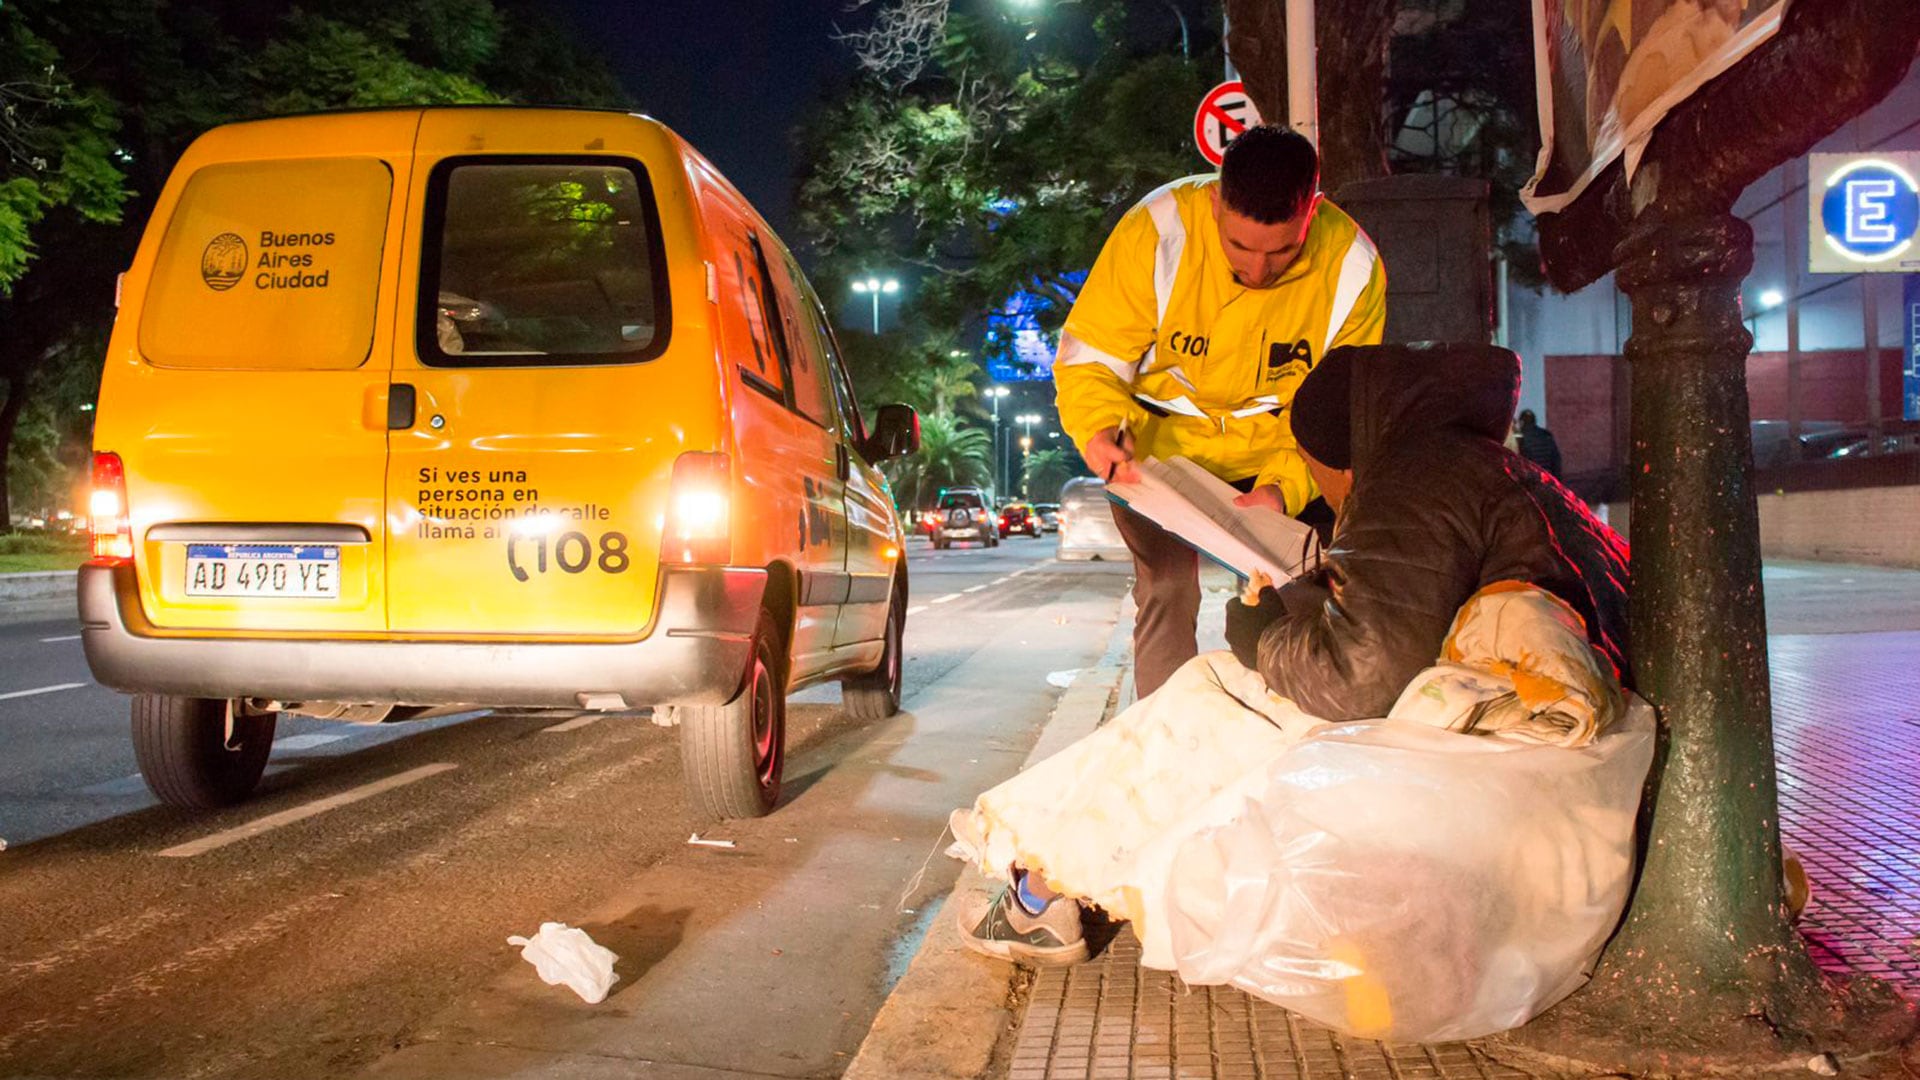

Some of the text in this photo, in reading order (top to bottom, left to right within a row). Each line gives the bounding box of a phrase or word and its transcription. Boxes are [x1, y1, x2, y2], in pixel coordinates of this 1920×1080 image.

[1846, 180, 1895, 243] E
[260, 231, 335, 247] Buenos
[257, 252, 313, 268] Aires
[255, 270, 329, 289] Ciudad
[418, 467, 527, 483] Si ves una
[418, 488, 538, 504] persona en
[418, 503, 515, 520] situación
[560, 503, 610, 520] calle
[418, 522, 475, 539] llamá
[530, 531, 629, 574] 108
[194, 562, 330, 591] AD 490 YE
